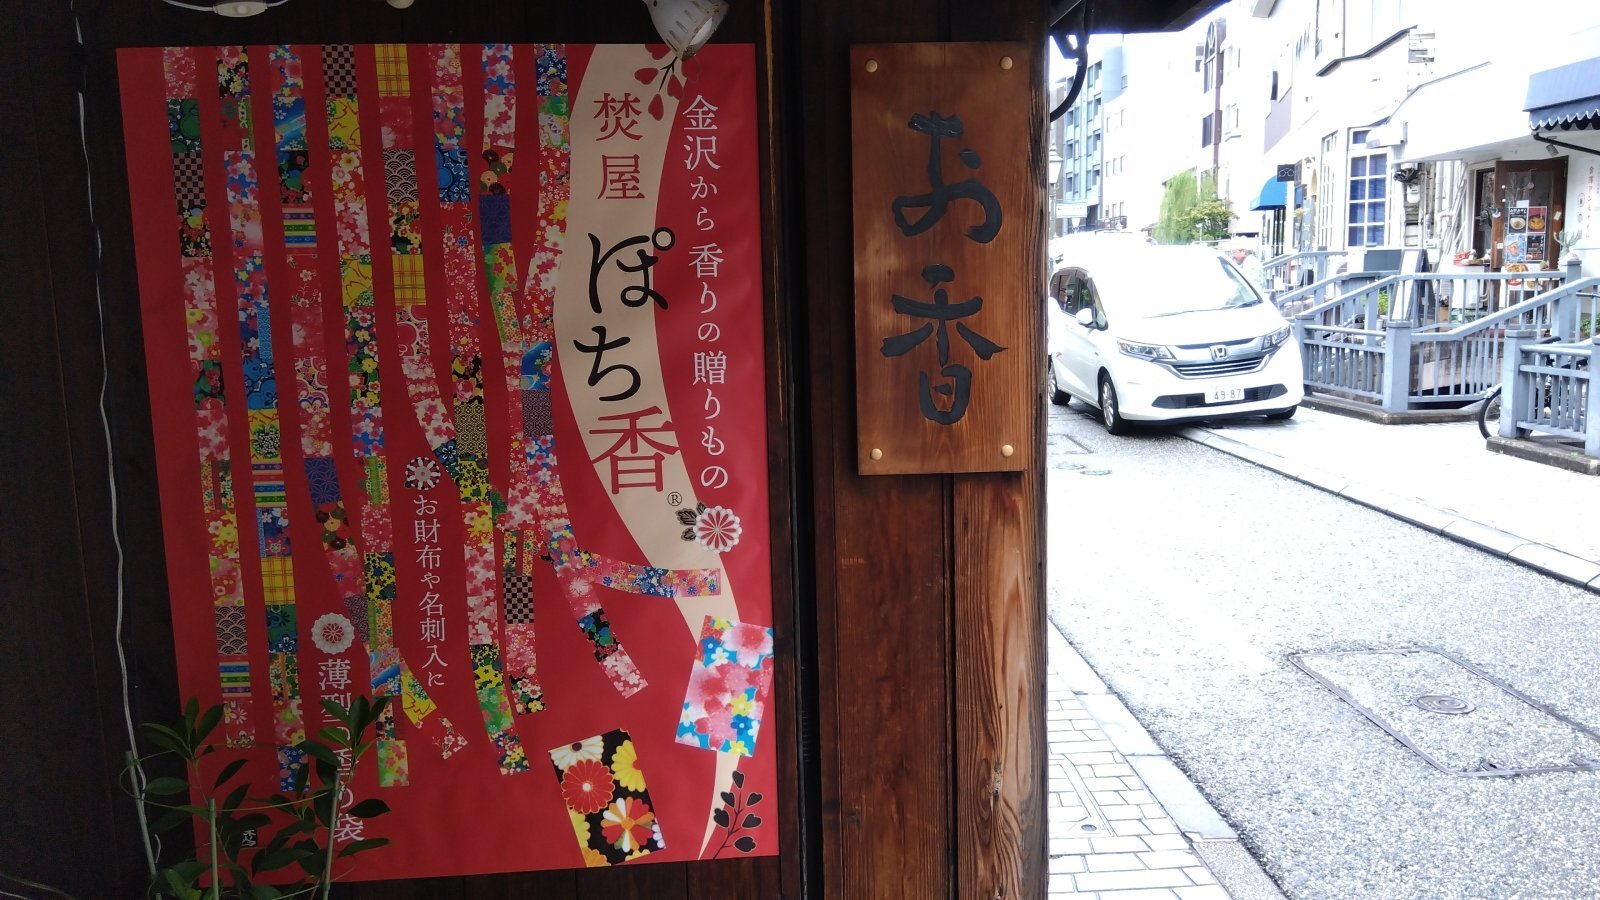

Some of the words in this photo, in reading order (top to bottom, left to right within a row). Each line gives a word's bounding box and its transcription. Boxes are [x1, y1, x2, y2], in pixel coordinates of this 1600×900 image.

[593, 93, 645, 199] 焚屋
[573, 227, 680, 494] ぽち香
[682, 94, 729, 489] 金沢から香りの贈りもの
[880, 111, 1008, 425] お香
[1214, 388, 1242, 400] 49-87
[413, 495, 447, 688] お財布や名刺入に
